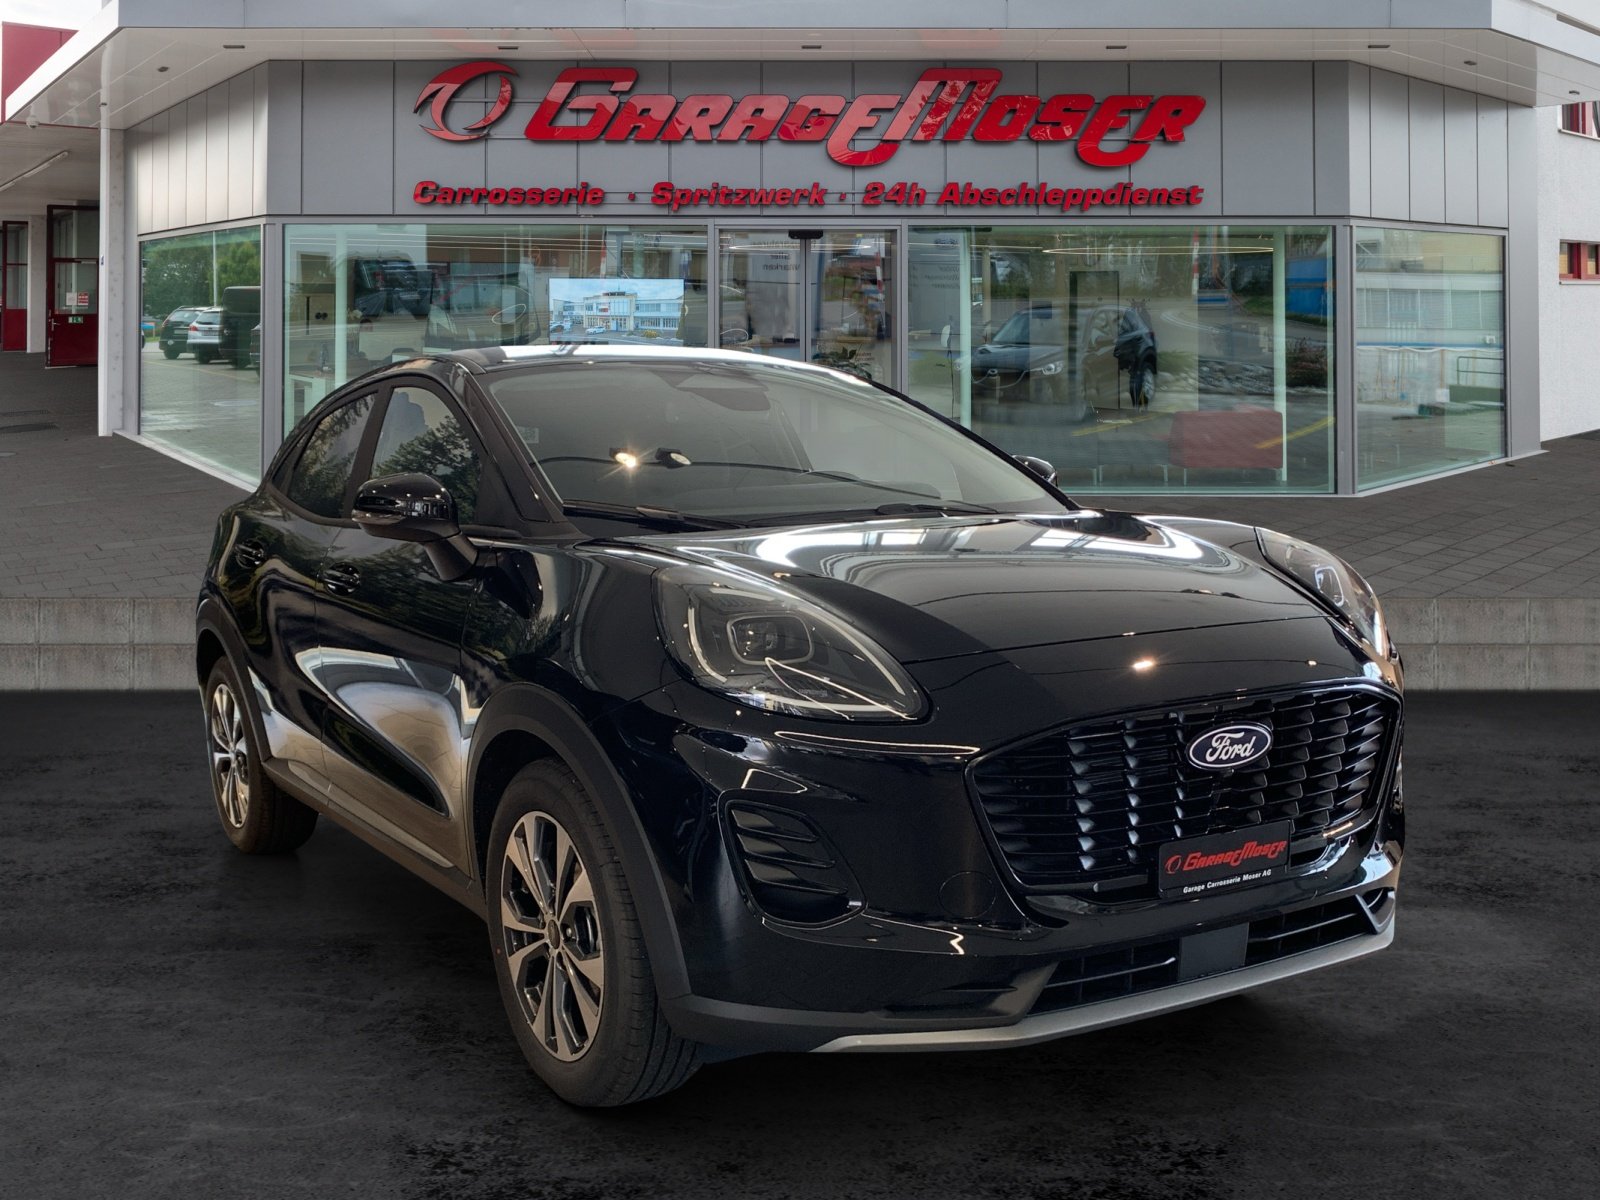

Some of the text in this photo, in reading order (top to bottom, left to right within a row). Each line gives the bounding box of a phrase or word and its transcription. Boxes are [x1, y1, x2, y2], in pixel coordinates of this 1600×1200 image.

[413, 181, 1203, 211] Carrosserie Spritzwerk 24h Abschleppdienst
[1205, 731, 1257, 762] Ford
[1183, 868, 1272, 893] Garage Carrosserie Moser AG
